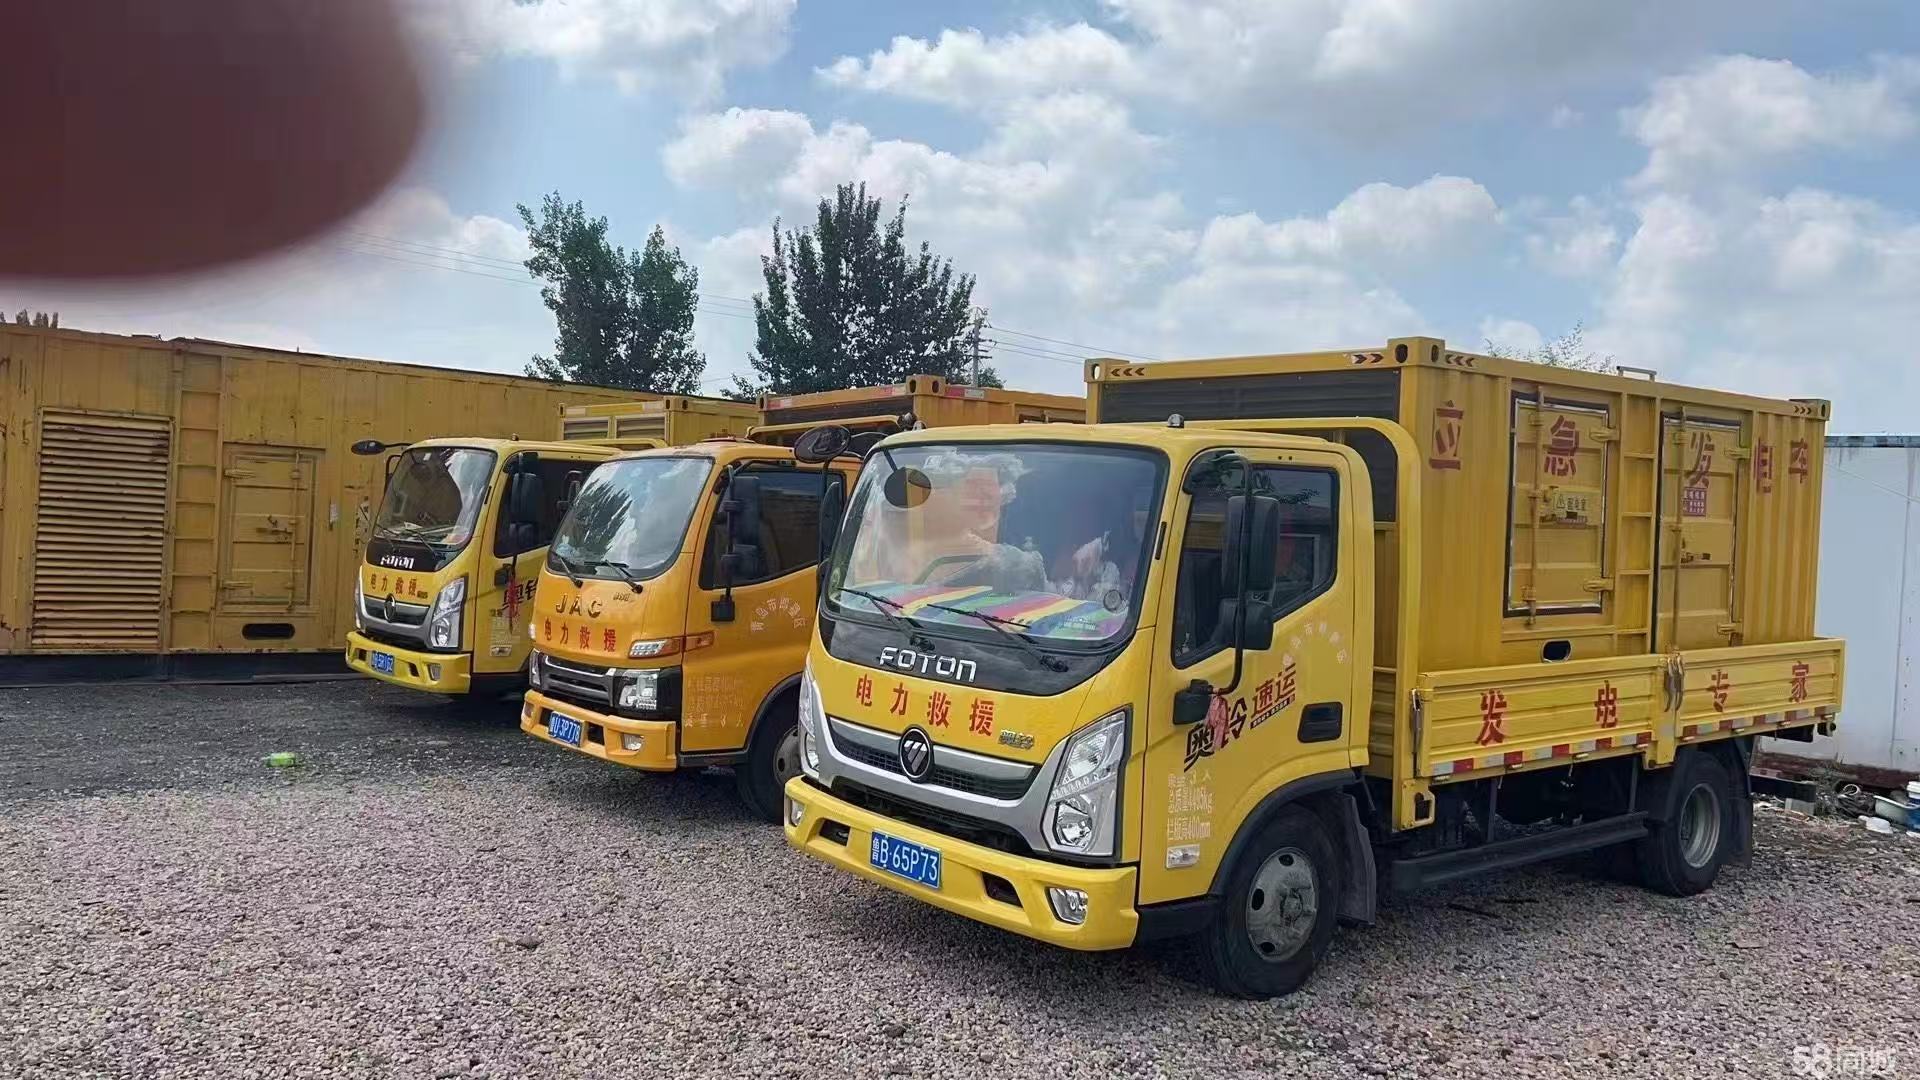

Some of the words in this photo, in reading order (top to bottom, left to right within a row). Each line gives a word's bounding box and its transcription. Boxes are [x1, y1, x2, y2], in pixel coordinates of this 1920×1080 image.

[370, 572, 417, 597] 电力救援
[555, 592, 603, 618] JAC
[544, 614, 617, 653] 电力救援
[879, 646, 977, 683] FOTON
[855, 673, 995, 737] 电力救援
[1475, 660, 1810, 746] 发电专家
